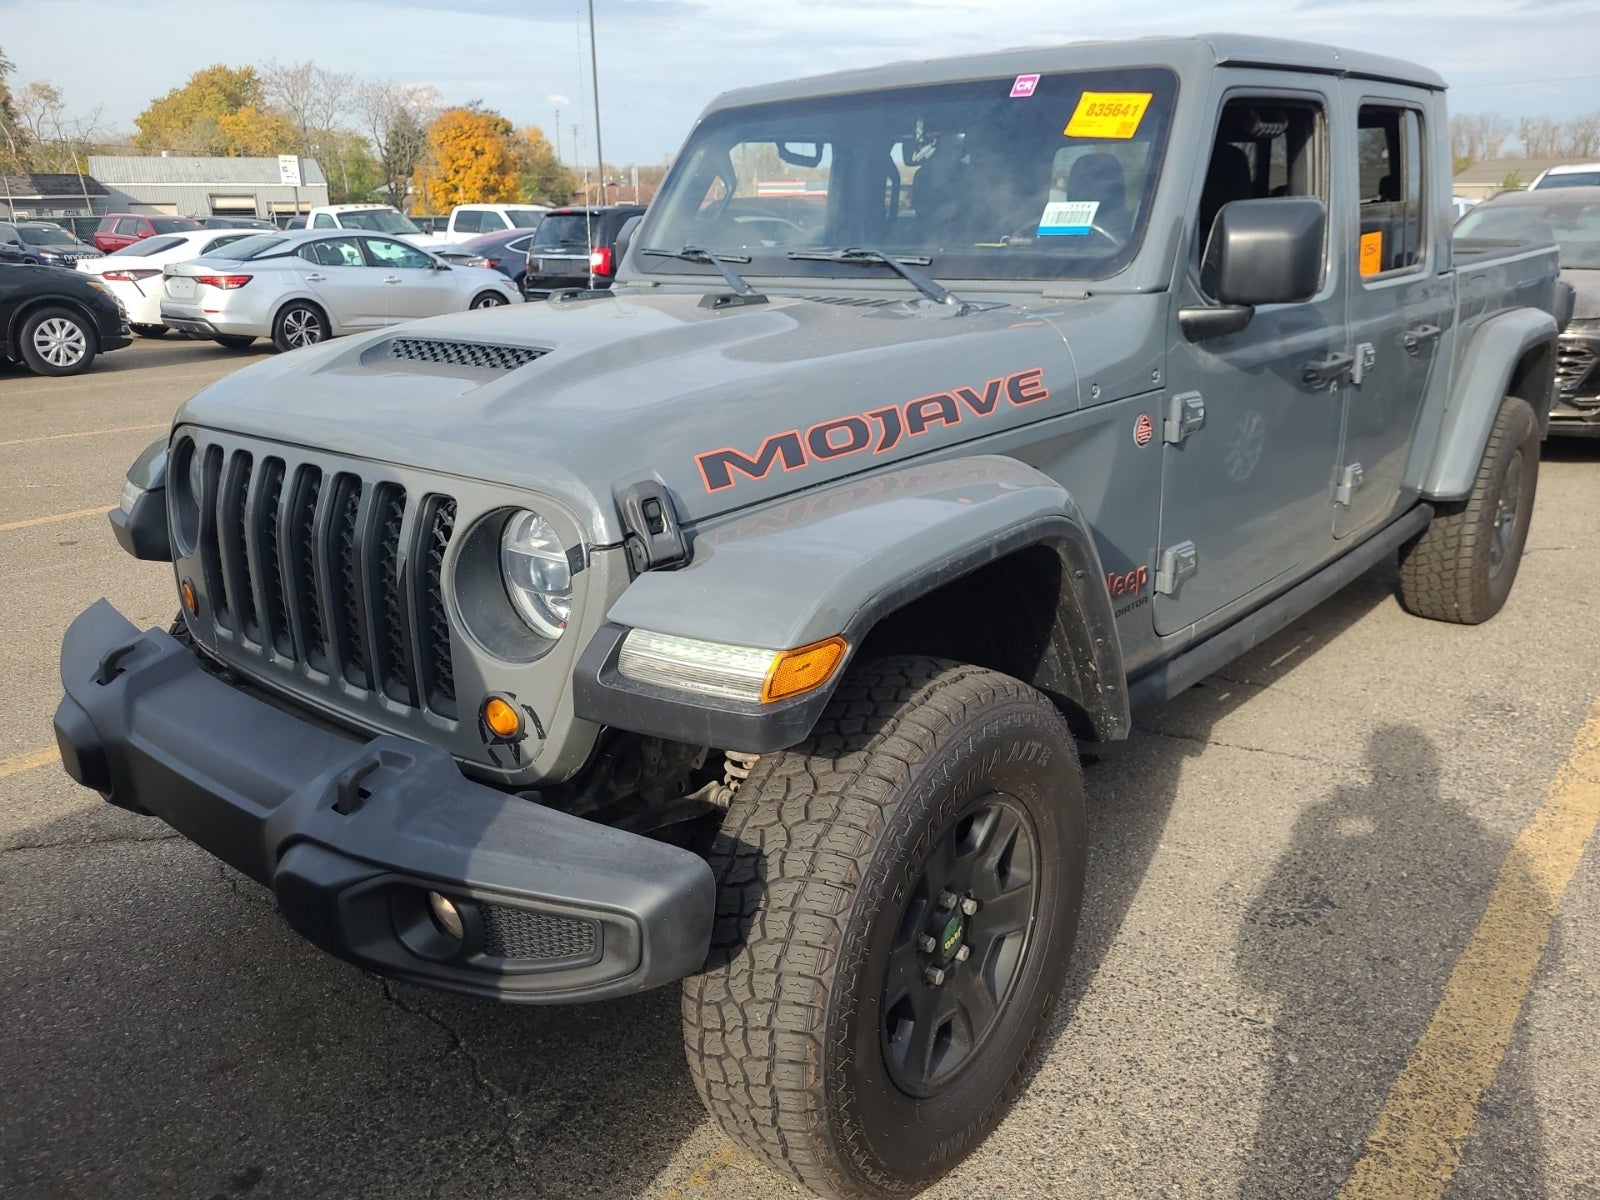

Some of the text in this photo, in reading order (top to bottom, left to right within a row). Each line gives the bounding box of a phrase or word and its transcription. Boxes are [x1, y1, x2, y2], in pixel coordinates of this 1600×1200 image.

[1086, 103, 1140, 118] 835641
[694, 366, 1049, 494] MOJAVE
[1114, 596, 1149, 618] DIATOR
